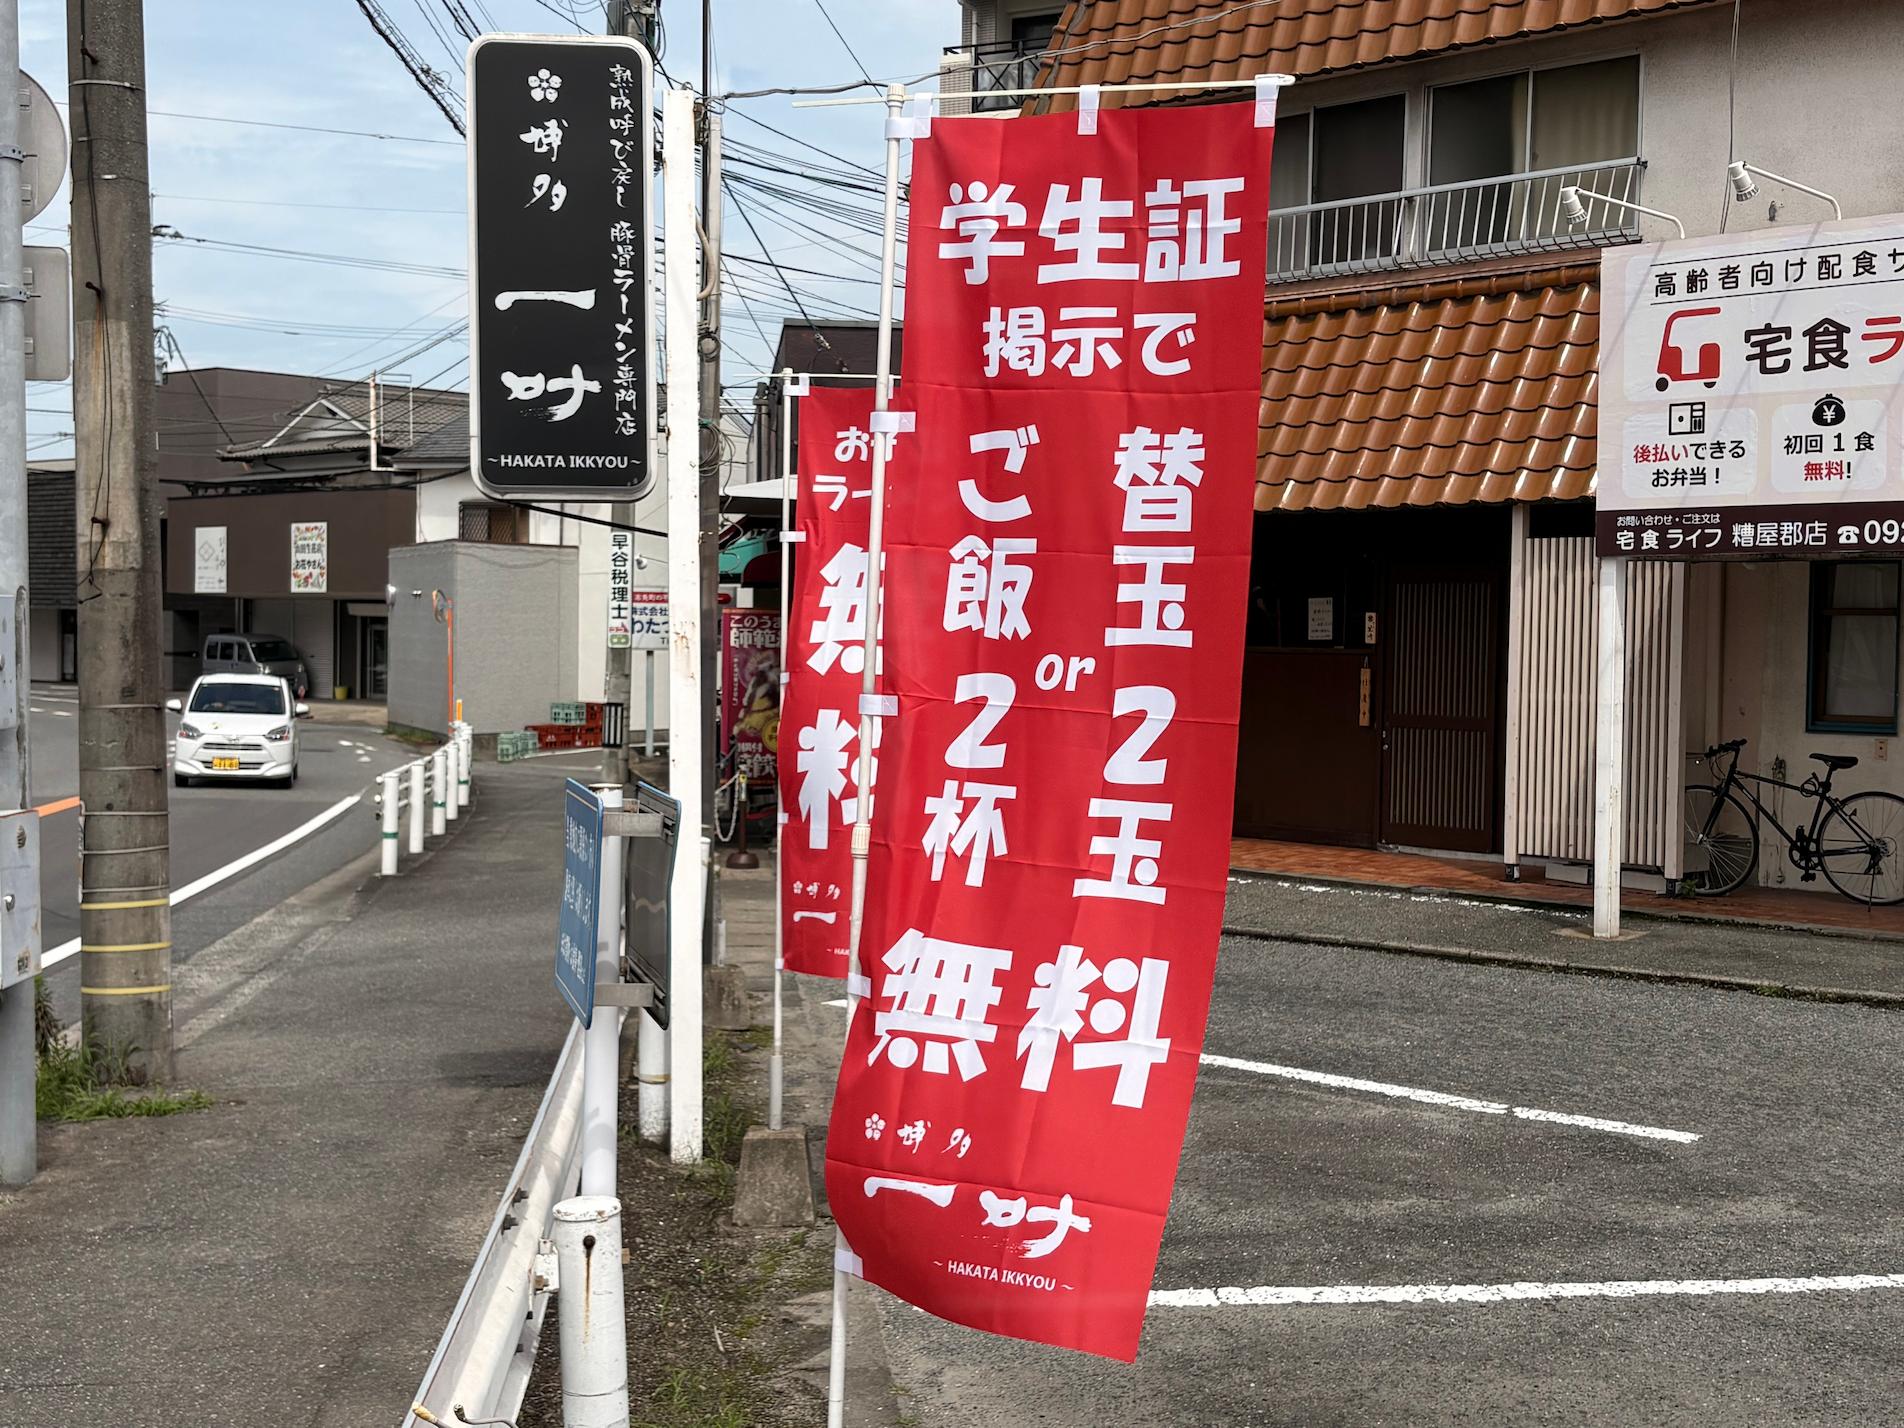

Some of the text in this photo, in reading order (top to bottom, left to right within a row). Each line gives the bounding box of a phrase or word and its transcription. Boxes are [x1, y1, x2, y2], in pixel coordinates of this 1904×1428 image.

[939, 177, 1245, 285] 学生証
[1655, 248, 1904, 297] 高齢者向け配食サ
[983, 306, 1197, 378] 掲示で
[1744, 317, 1904, 375] 宅食ラ
[500, 454, 565, 468] HAKATA
[569, 455, 628, 469] IKKYOU
[1634, 440, 1746, 464] 後払いできる
[1732, 521, 1828, 548] 糟屋郡店
[611, 534, 629, 620] 早谷税理士
[1035, 654, 1096, 692] or
[868, 928, 1172, 1109] 無料
[948, 1260, 998, 1281] HAKATA
[1001, 1269, 1056, 1291] IKKYOU
